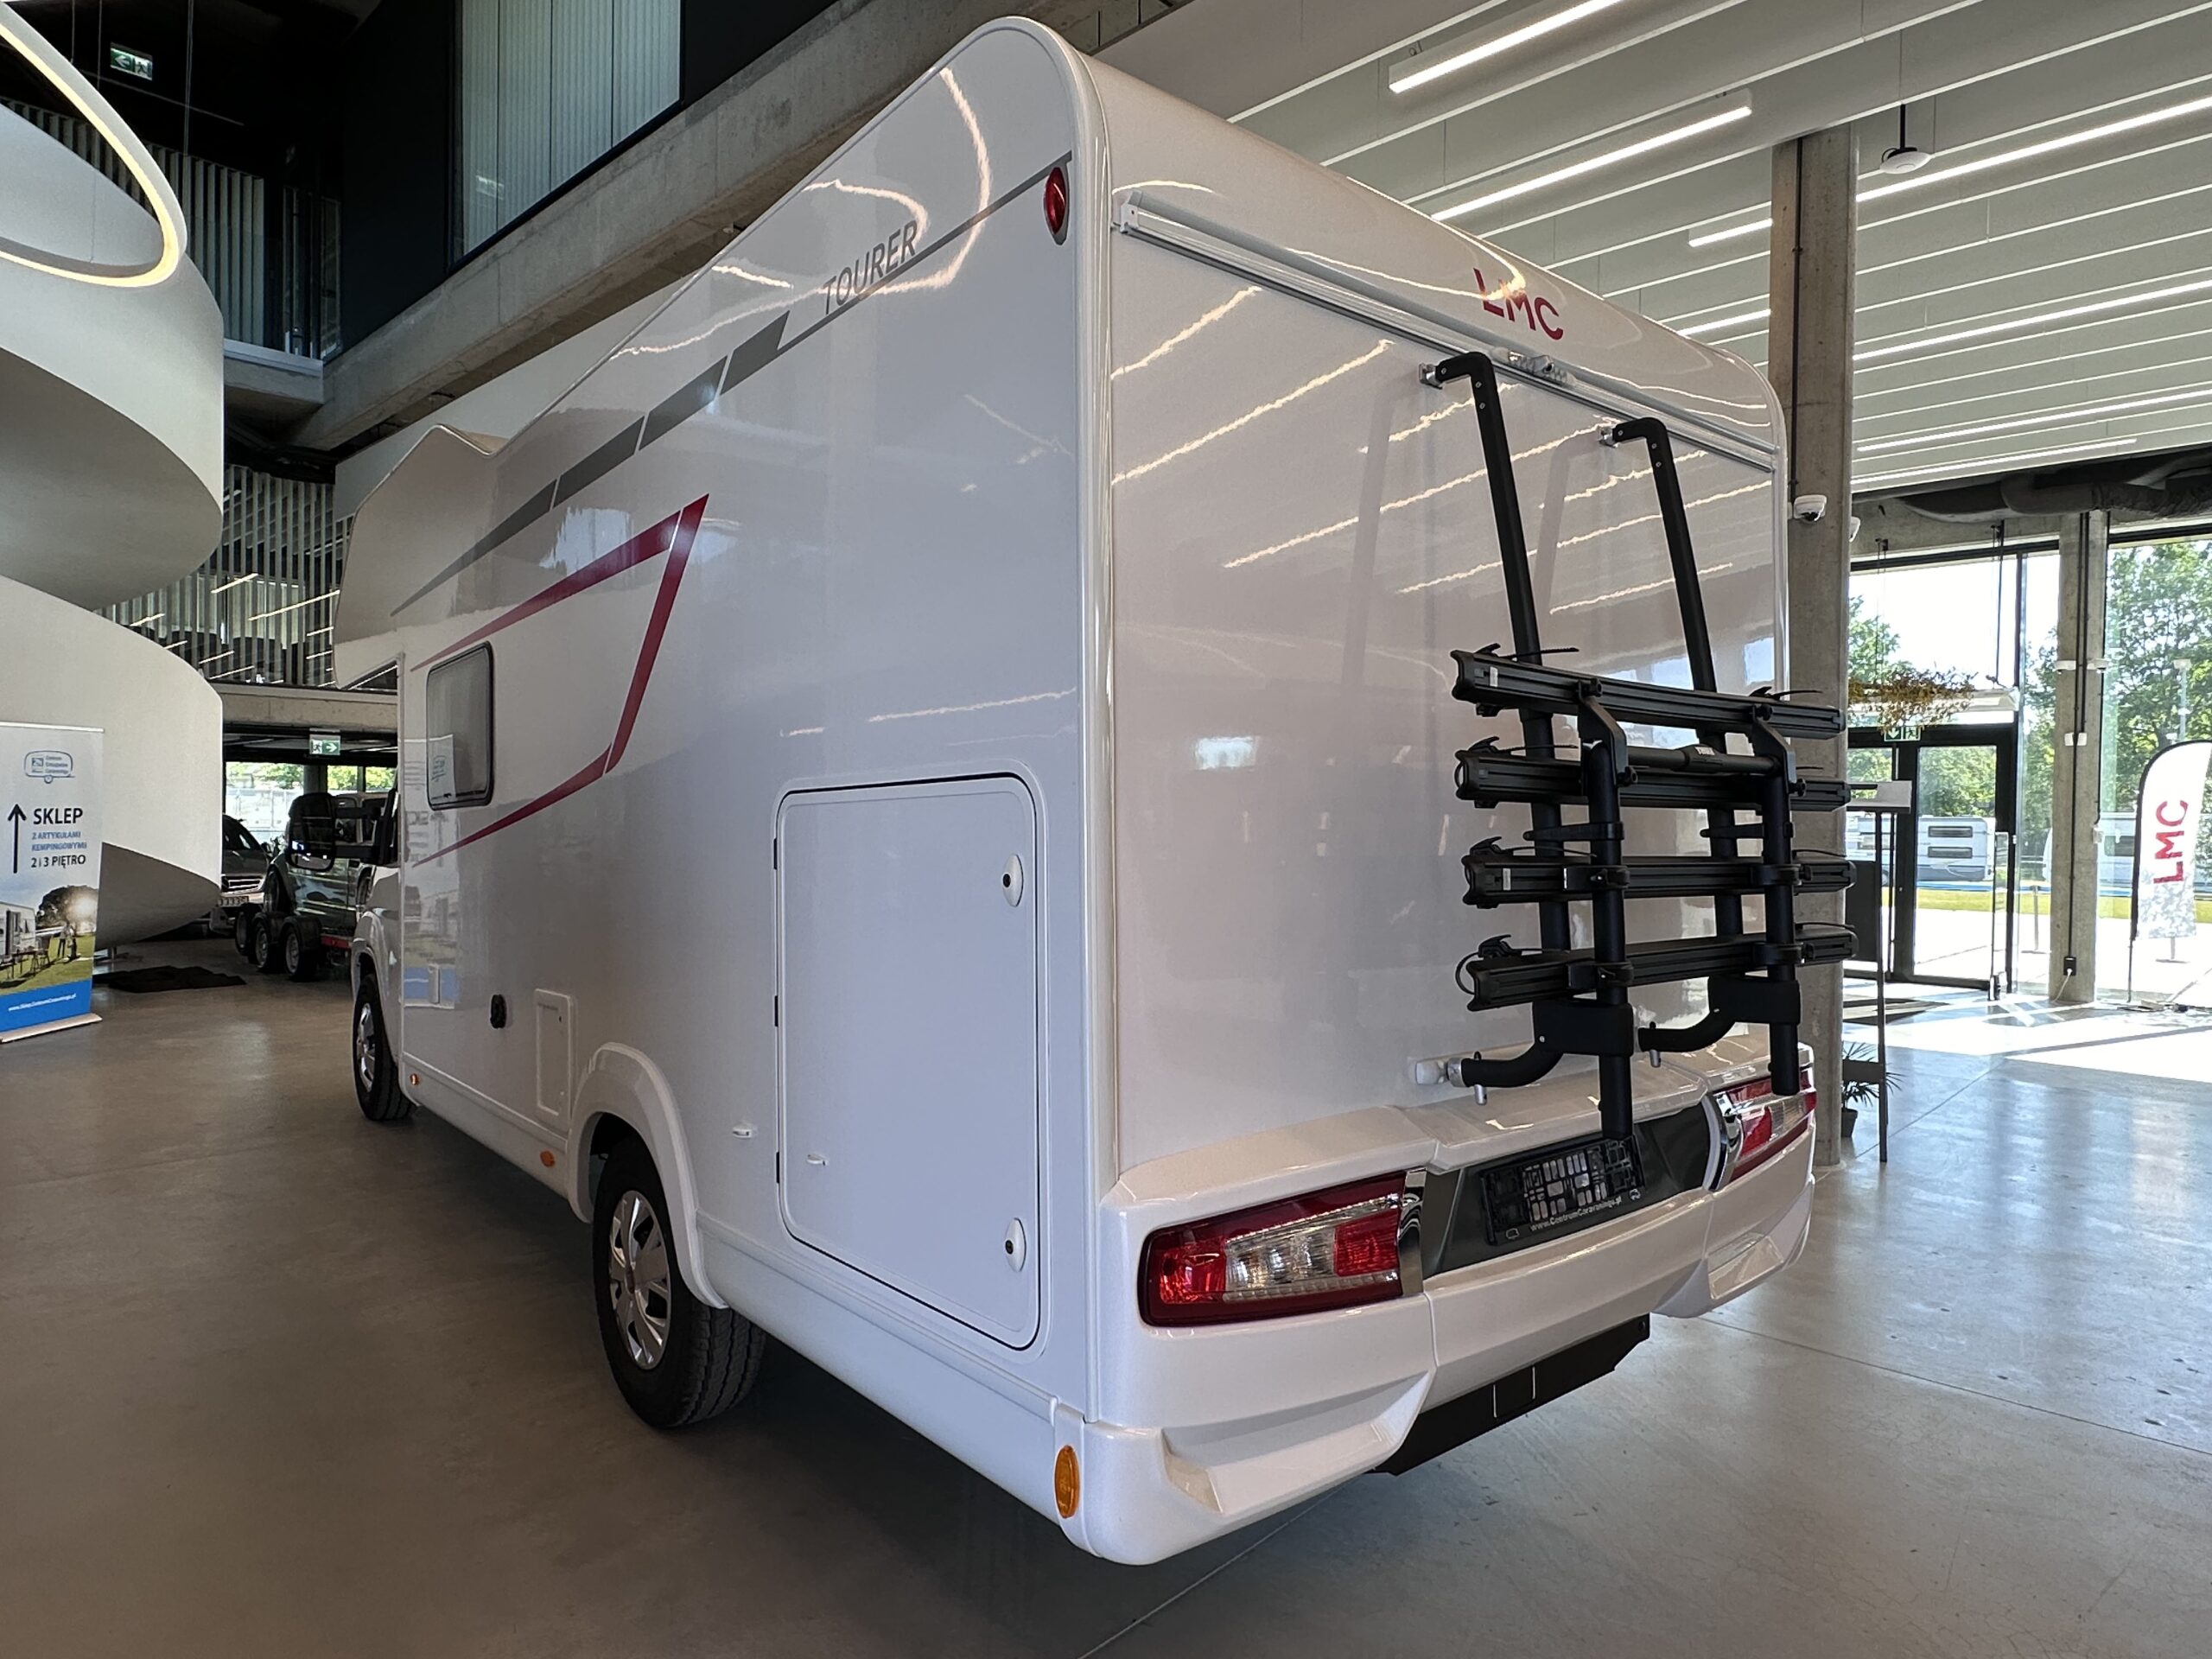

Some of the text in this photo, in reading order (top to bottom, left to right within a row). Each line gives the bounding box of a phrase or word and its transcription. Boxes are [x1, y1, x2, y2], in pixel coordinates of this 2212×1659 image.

[823, 220, 918, 315] TOURER
[1472, 267, 1564, 340] LMC
[33, 808, 84, 824] SKLEP
[2153, 799, 2189, 884] LMC
[31, 857, 37, 868] 2
[43, 856, 49, 868] 3
[51, 854, 86, 869] PIĘTRO
